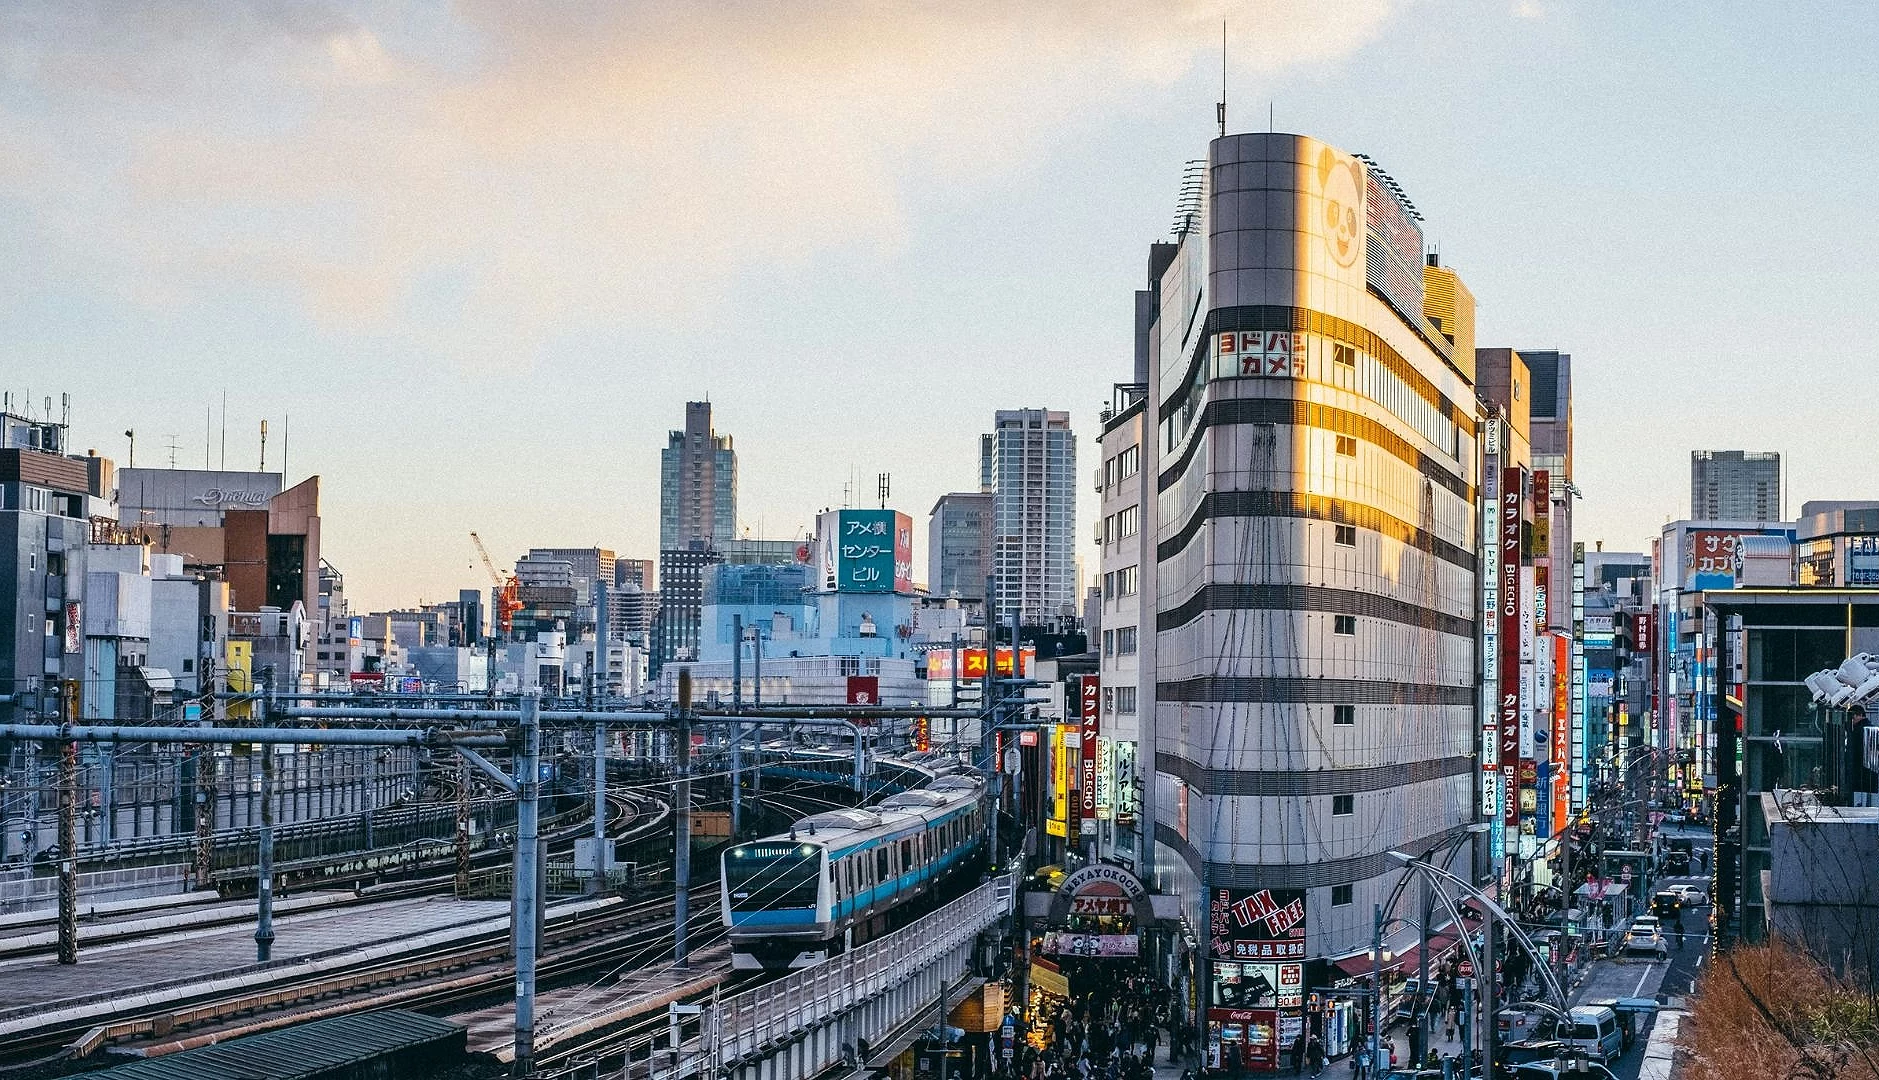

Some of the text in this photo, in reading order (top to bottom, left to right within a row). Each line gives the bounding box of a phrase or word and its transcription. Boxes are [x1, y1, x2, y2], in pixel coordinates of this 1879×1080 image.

[846, 521, 887, 535] アメ横
[1505, 492, 1518, 551] カラオケ
[841, 545, 892, 559] センター
[1084, 684, 1097, 741] カラオケ
[1503, 693, 1517, 752] カラオケ
[1486, 731, 1494, 764] MASUYA
[1118, 758, 1130, 813] ルノアール
[1485, 779, 1494, 810] ルノアール
[1211, 900, 1220, 935] カメラ
[1219, 889, 1230, 935] ヨドバシ
[1231, 889, 1280, 928] TAX
[1264, 897, 1305, 938] FREE
[1236, 943, 1305, 956] 免税品取扱店
